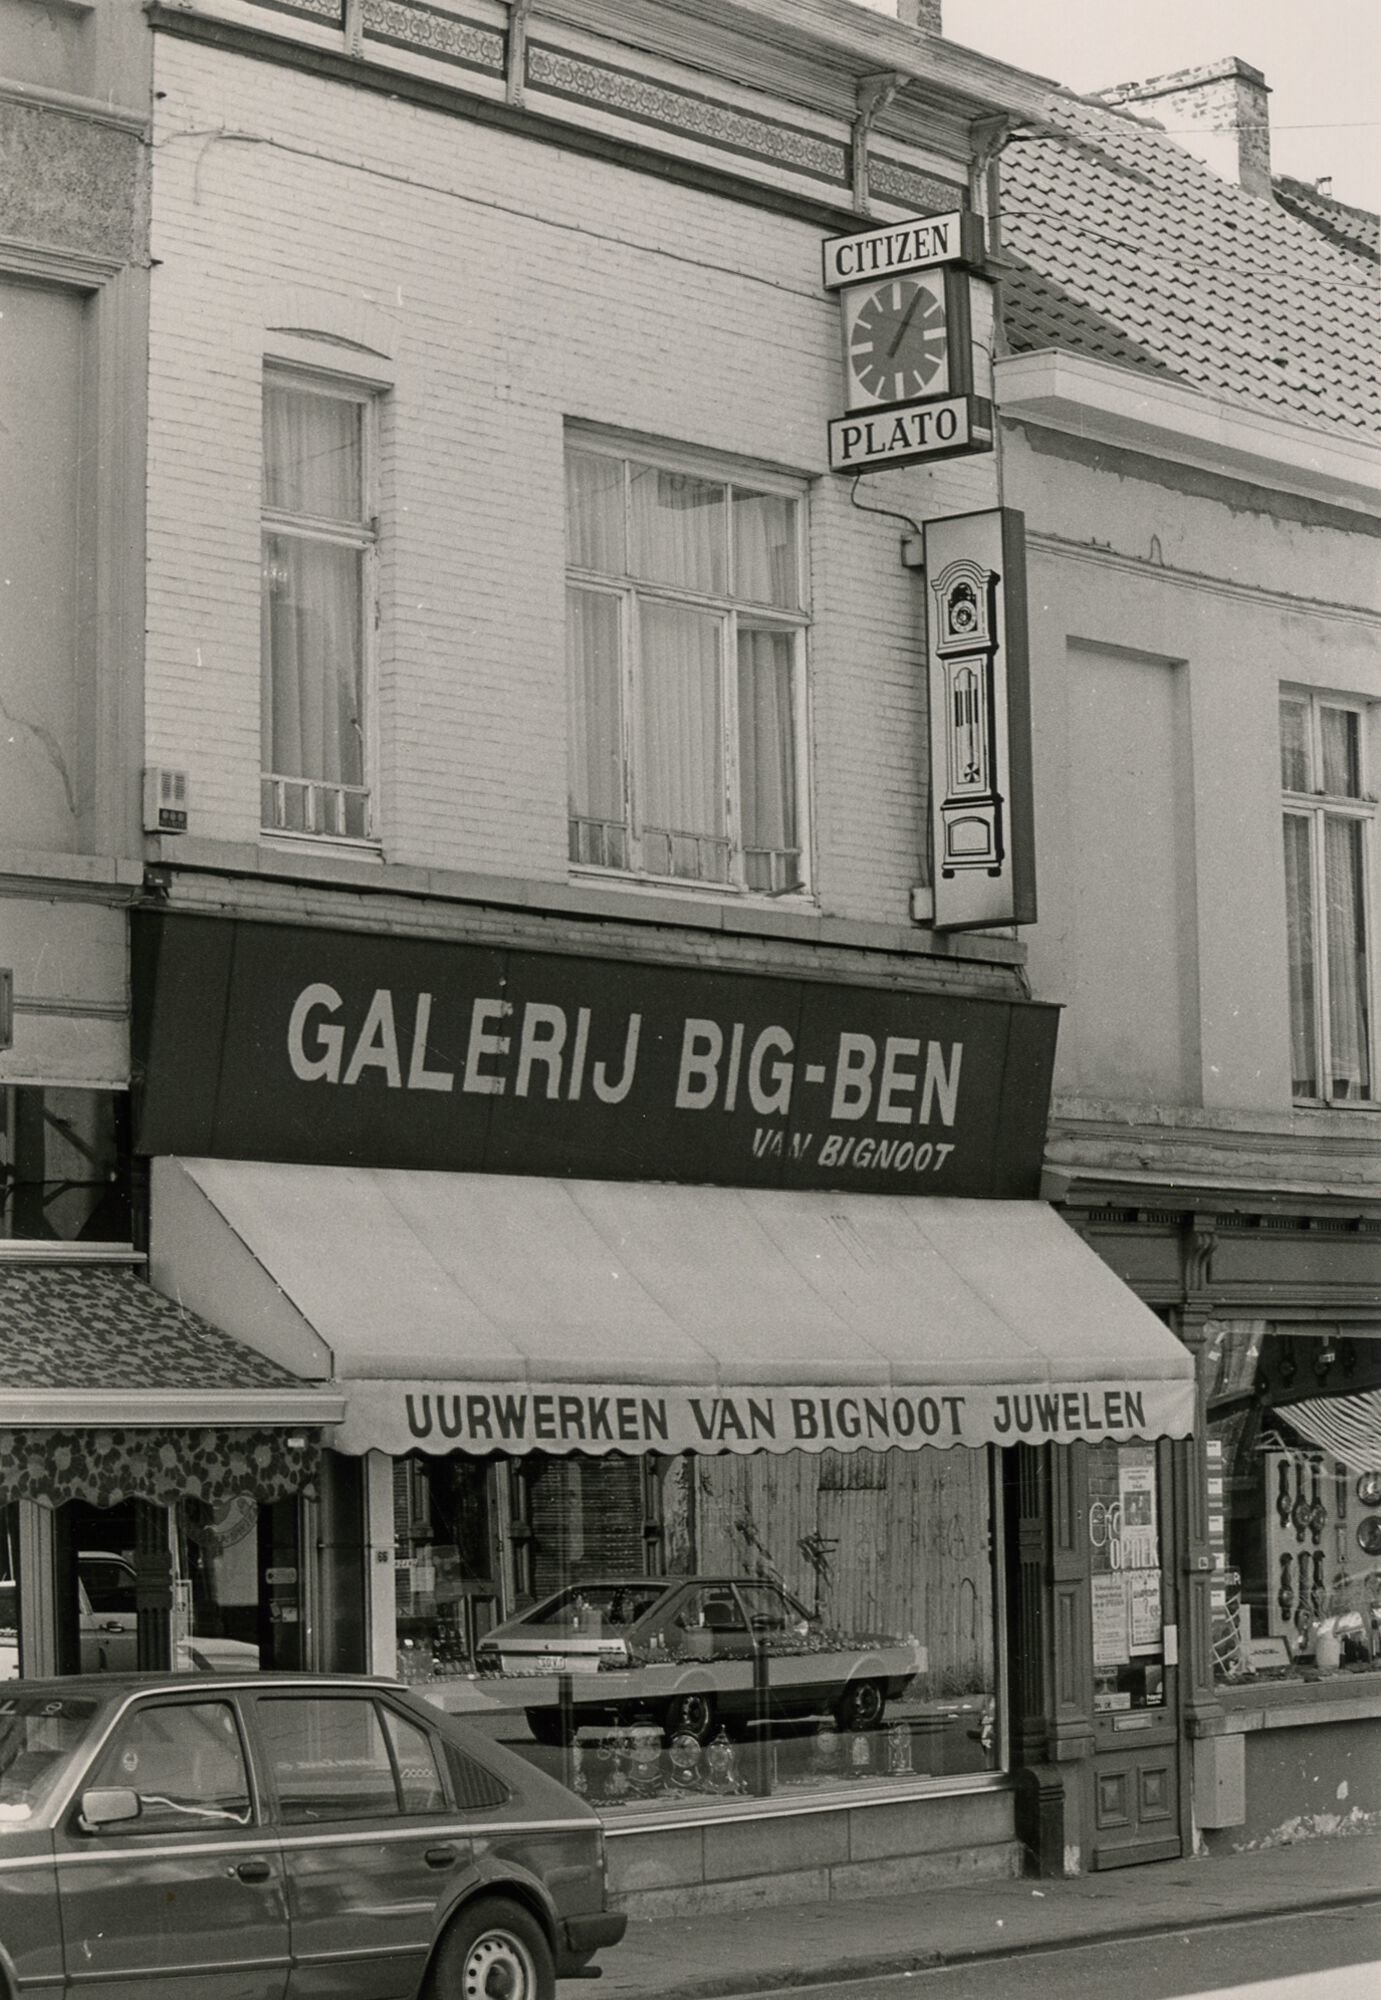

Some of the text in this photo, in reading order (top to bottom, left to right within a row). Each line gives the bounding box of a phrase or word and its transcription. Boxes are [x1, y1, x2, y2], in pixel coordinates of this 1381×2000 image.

[835, 223, 950, 276] CITIZEN
[841, 408, 958, 460] PLATO
[287, 982, 963, 1126] GALERIJ BIG-BEN
[817, 1135, 955, 1172] BIGNOOT
[405, 1391, 1147, 1440] UURWERKEN VAN BIGNOOT JUWELEN
